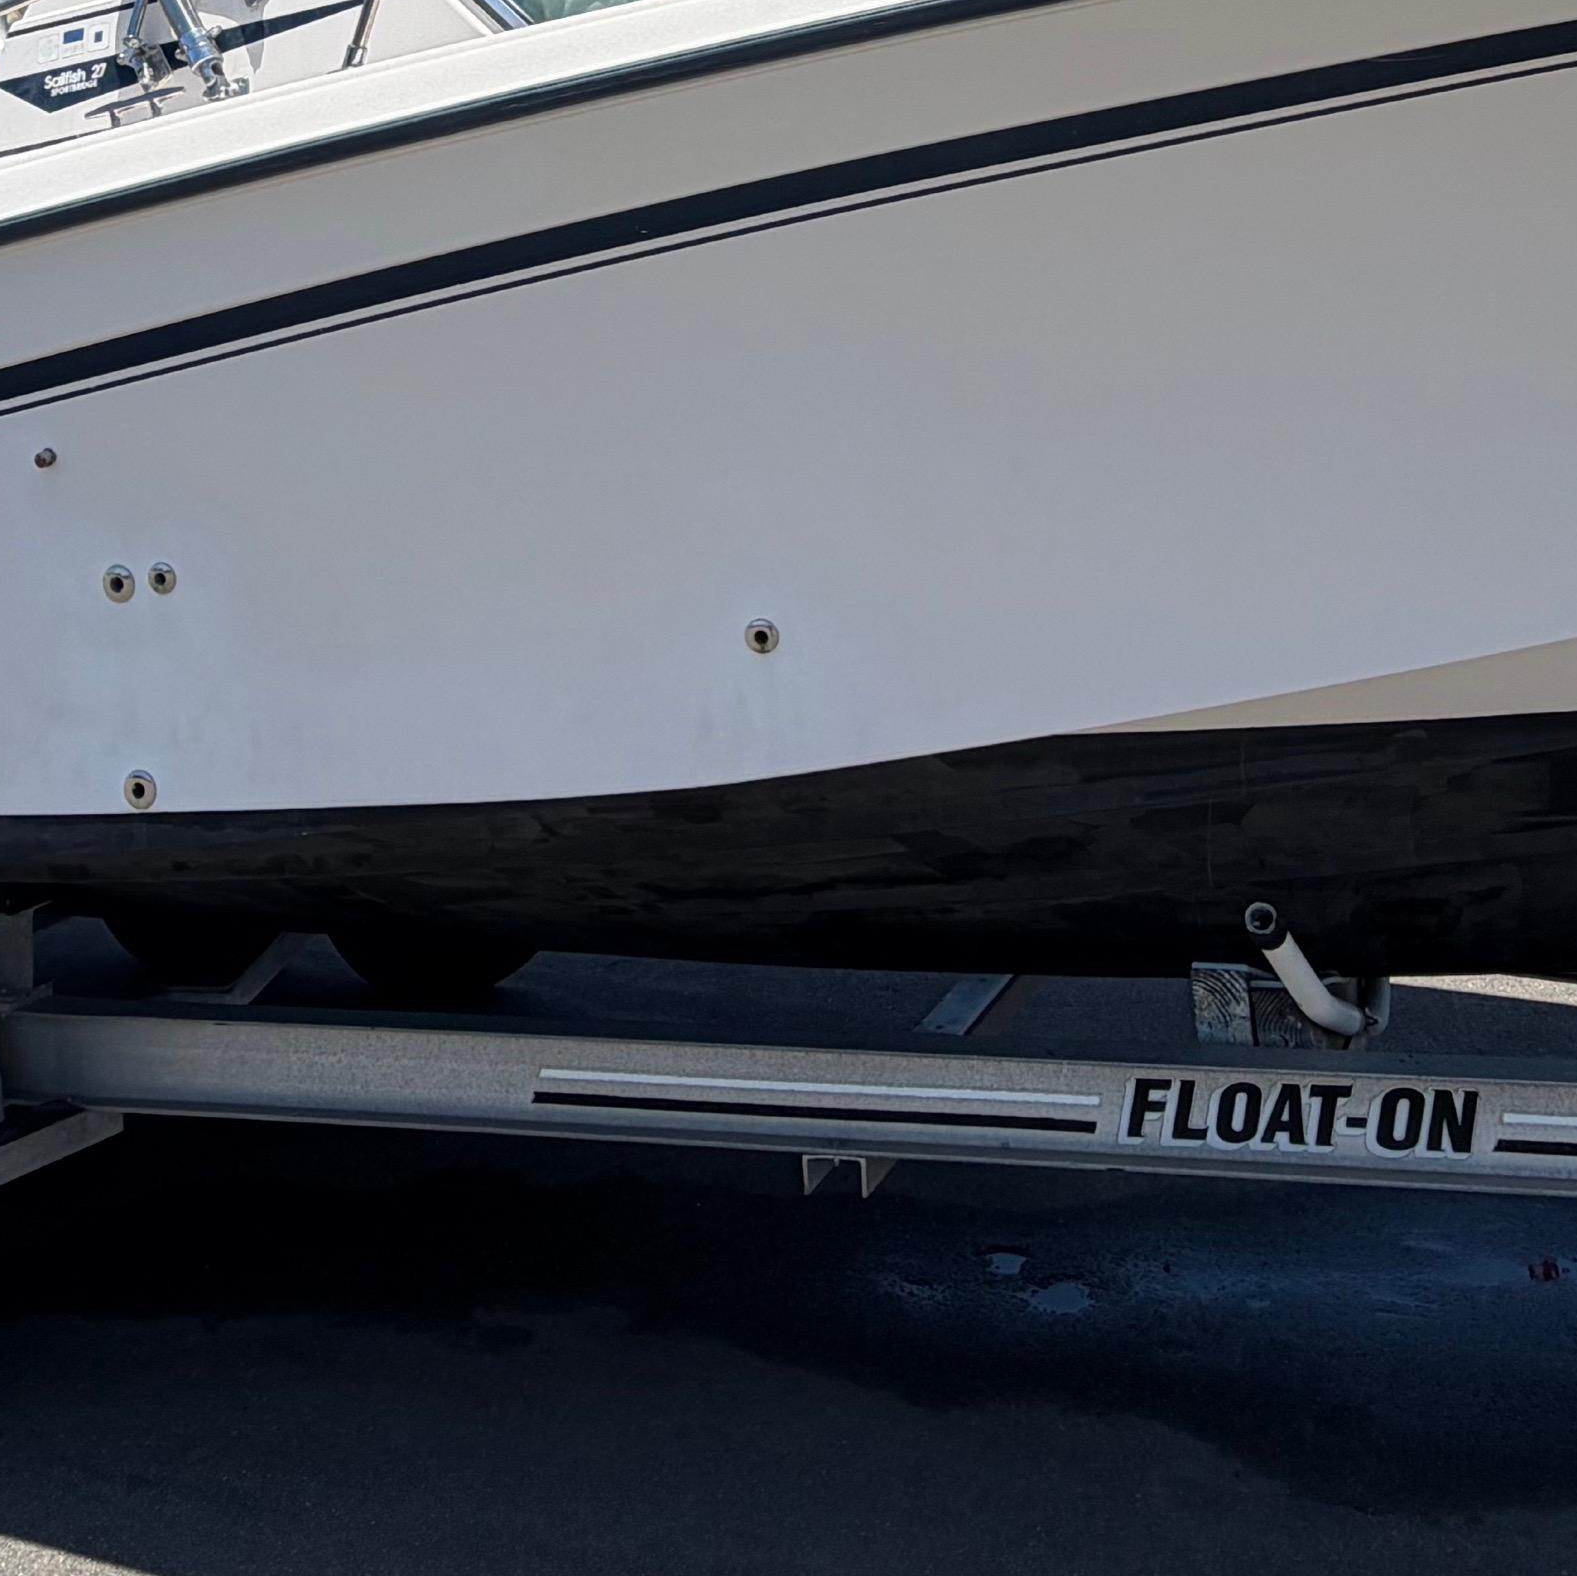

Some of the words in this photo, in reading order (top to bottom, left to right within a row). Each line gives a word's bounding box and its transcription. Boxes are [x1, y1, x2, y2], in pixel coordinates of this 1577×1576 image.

[44, 68, 86, 90] Sailfish
[91, 62, 107, 79] 27
[1122, 1075, 1480, 1158] FLOAT-ON
